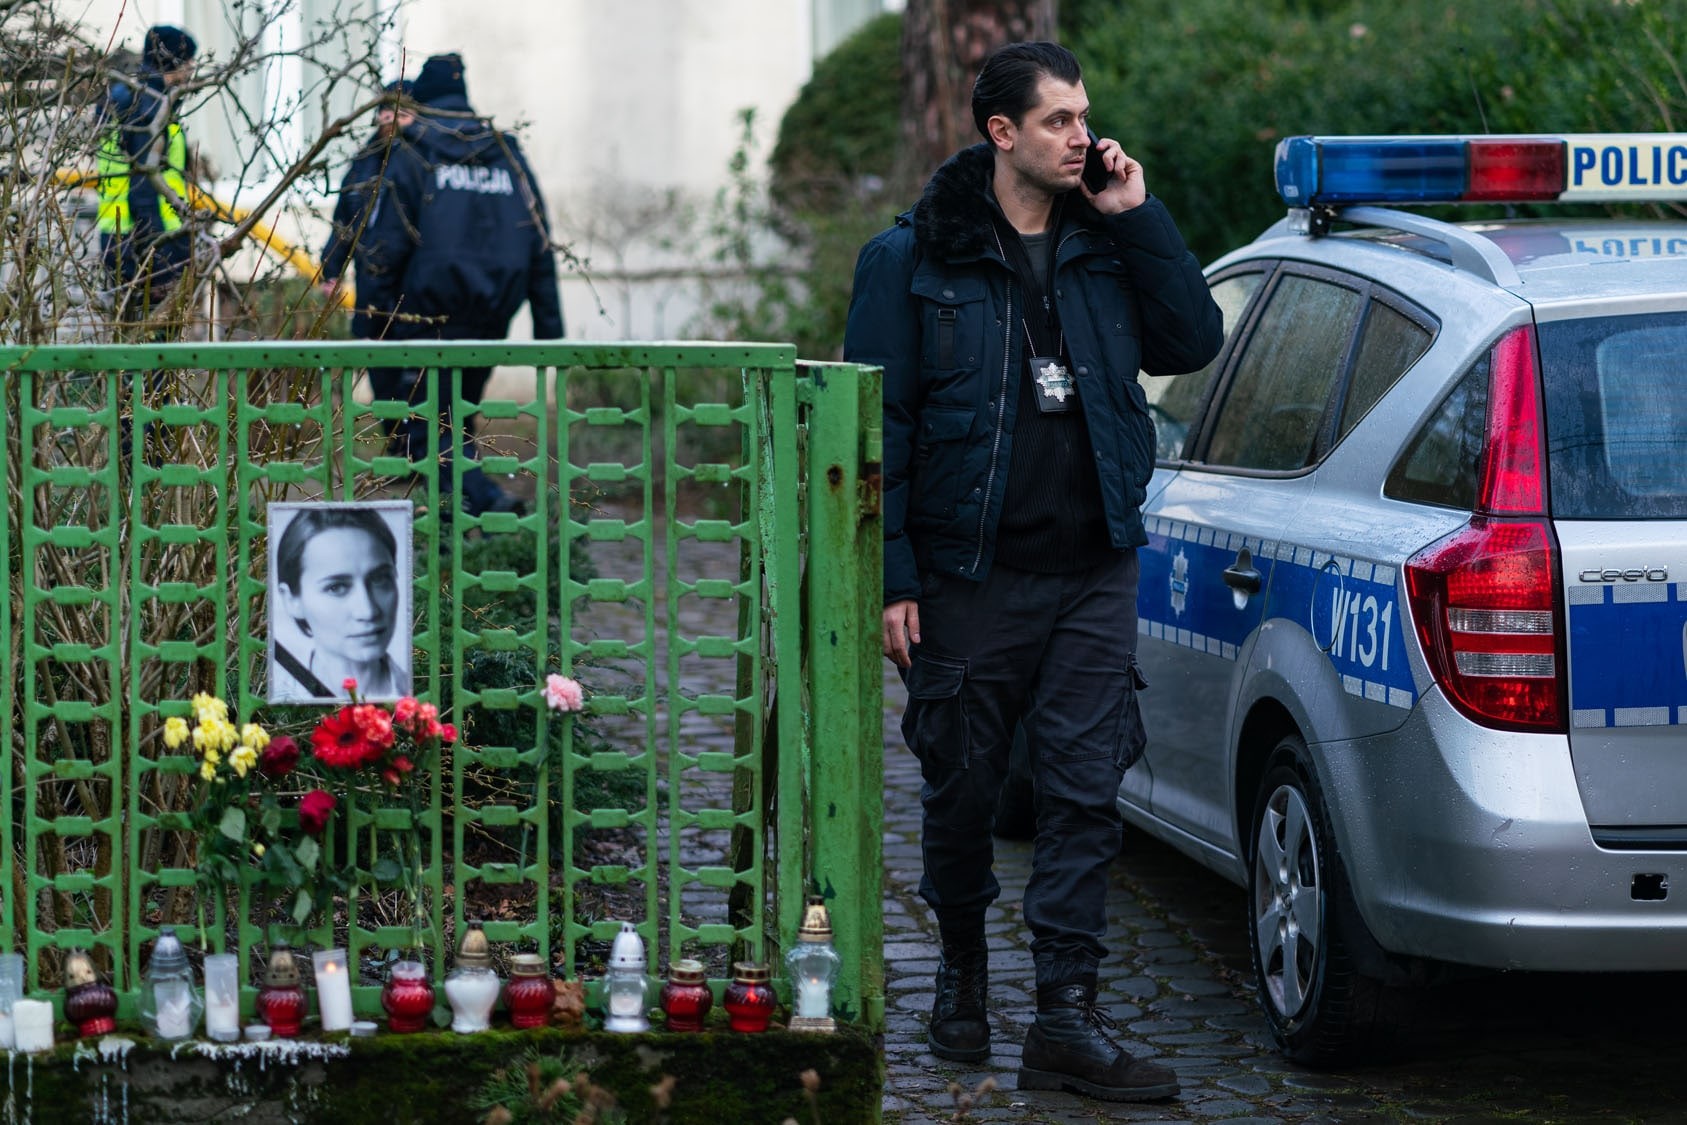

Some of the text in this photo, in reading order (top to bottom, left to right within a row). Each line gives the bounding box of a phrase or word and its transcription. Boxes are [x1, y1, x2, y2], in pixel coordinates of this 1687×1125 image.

[436, 163, 514, 196] POLICJA
[1573, 145, 1687, 186] POLIC
[1331, 586, 1393, 671] W131
